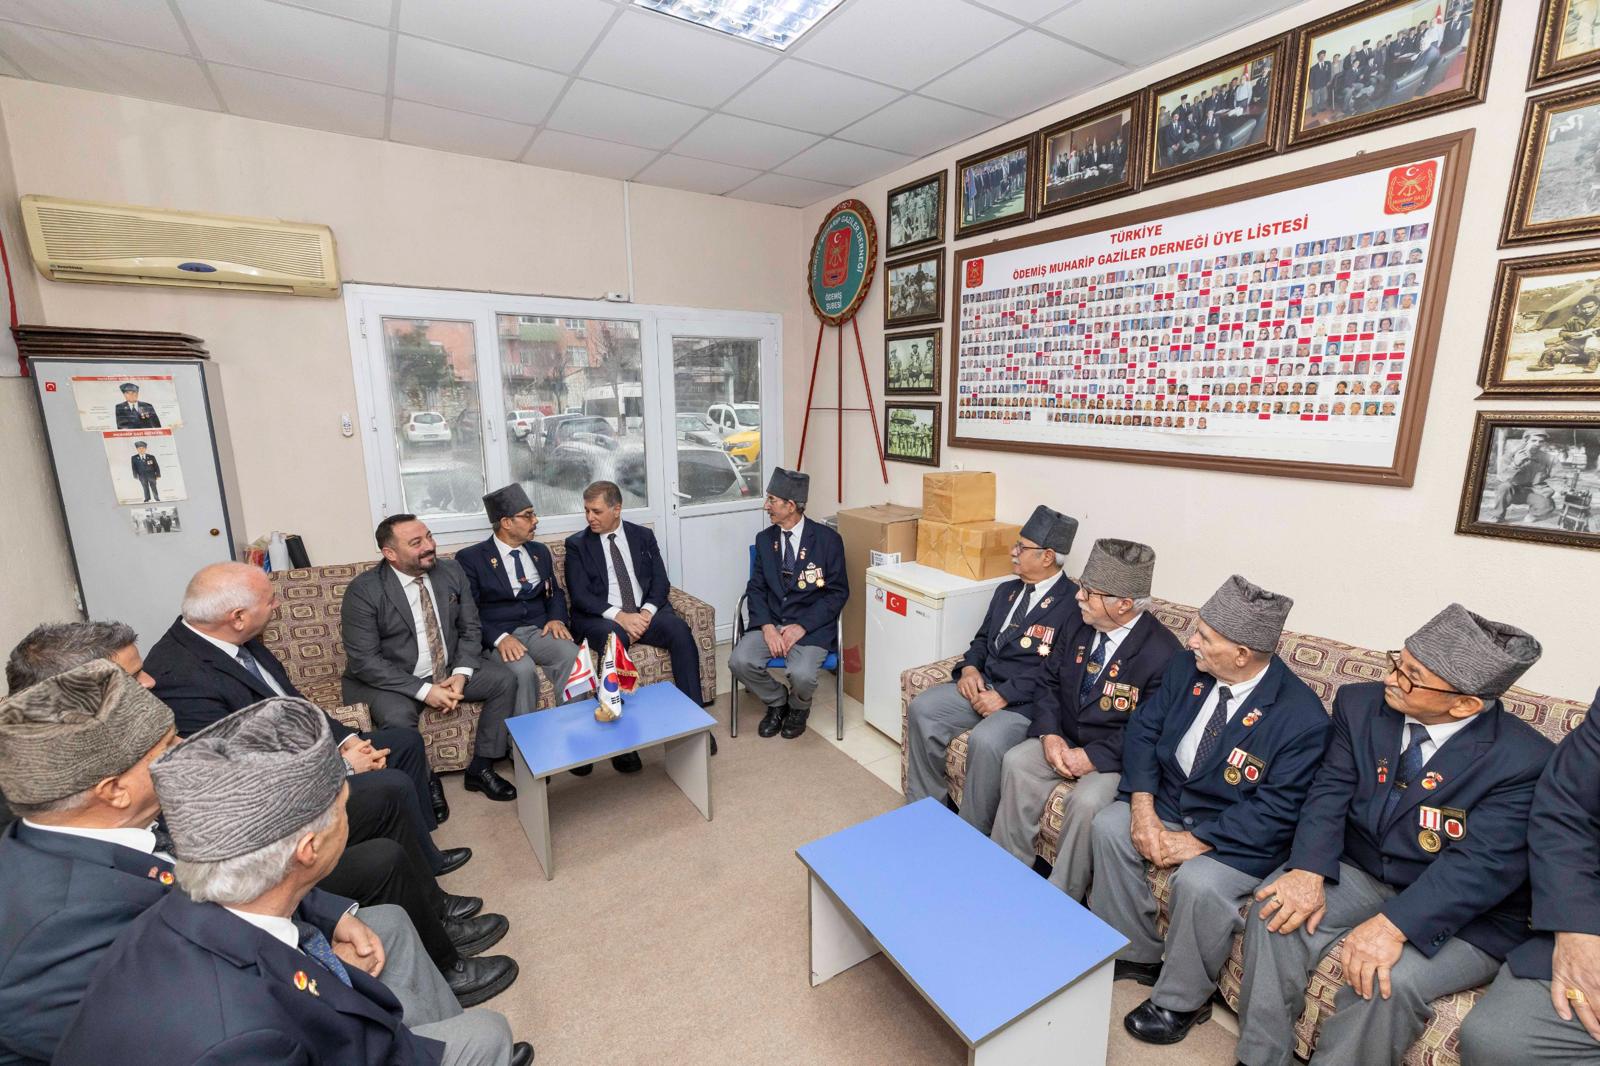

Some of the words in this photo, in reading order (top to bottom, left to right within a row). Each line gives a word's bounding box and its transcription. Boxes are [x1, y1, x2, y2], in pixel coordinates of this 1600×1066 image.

[1013, 264, 1047, 281] ÖDEMİŞ
[1050, 255, 1096, 274] MUHARİP
[1098, 246, 1147, 266] GAZİLER
[1150, 234, 1209, 257] DERNEĞİ
[1213, 229, 1243, 247] ÜYE
[1247, 213, 1309, 241] LİSTESİ
[1111, 224, 1163, 244] TÜRKİYE
